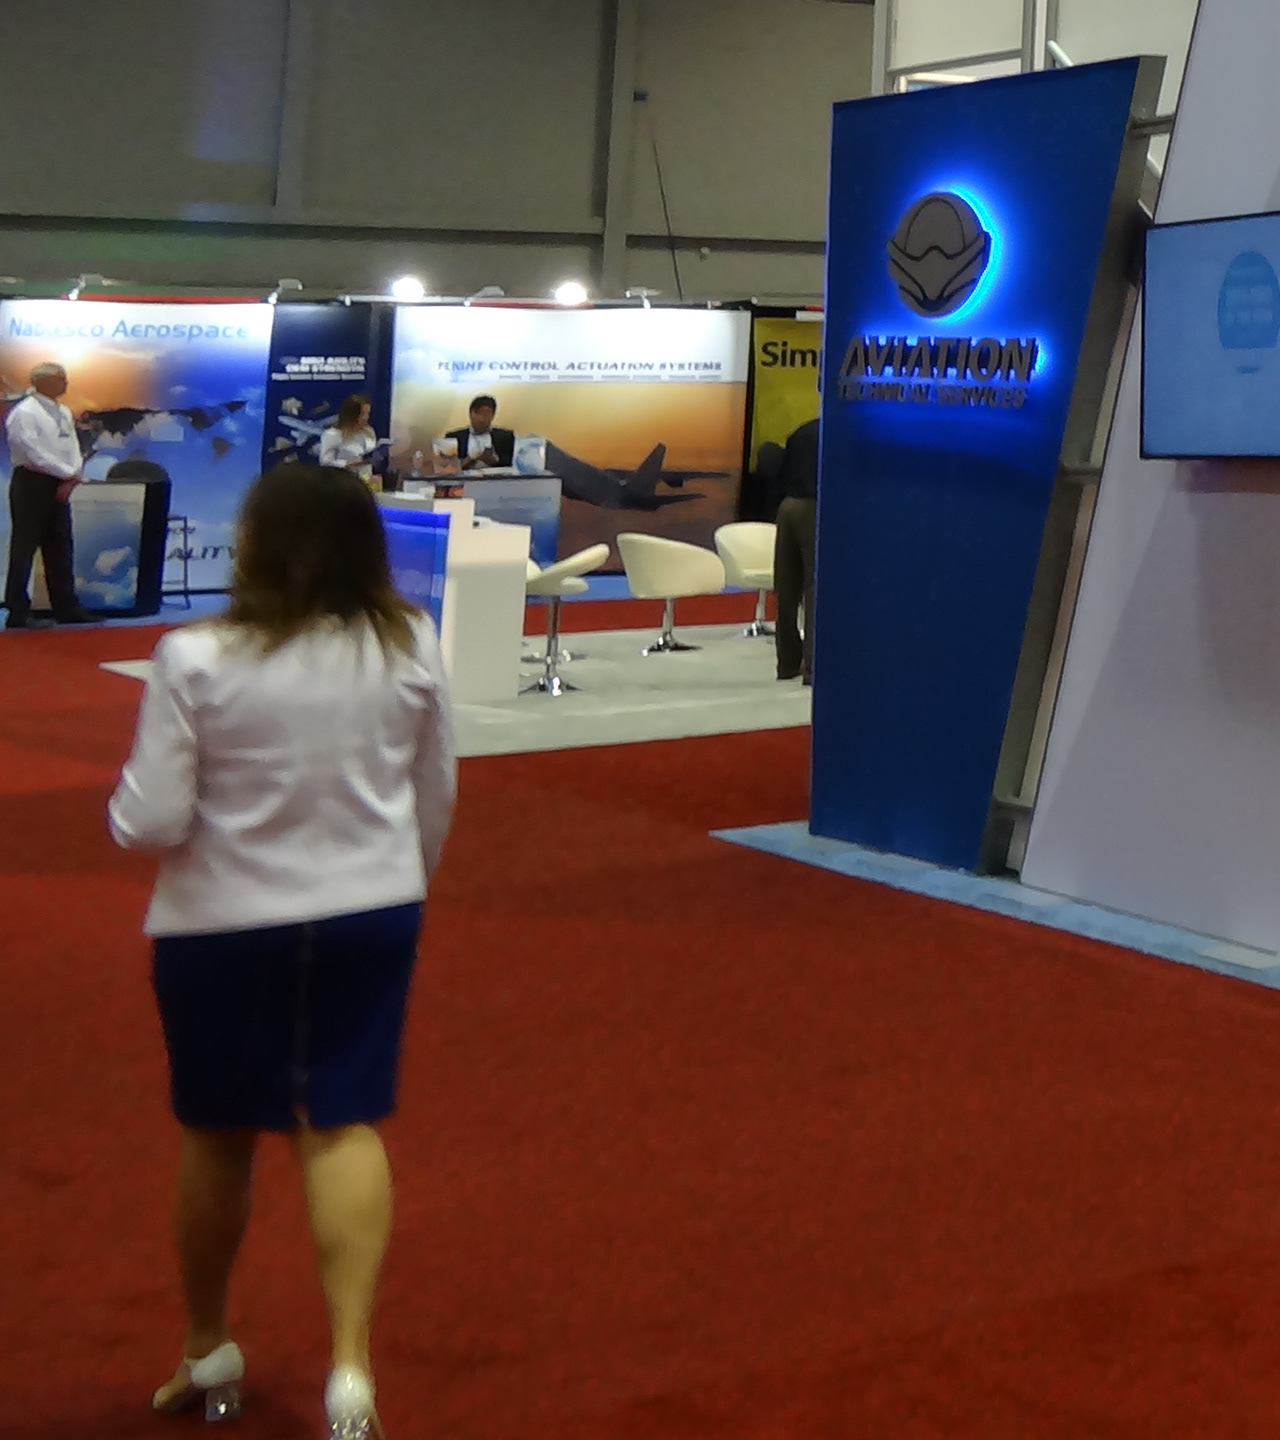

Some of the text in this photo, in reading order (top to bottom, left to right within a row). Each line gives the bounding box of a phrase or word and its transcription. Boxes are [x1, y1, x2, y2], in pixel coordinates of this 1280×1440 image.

[112, 320, 248, 341] Aerospace
[488, 361, 558, 371] CONTROL
[565, 362, 654, 371] ACTUATION
[659, 362, 722, 371] SYSTEMS
[839, 336, 1038, 382] AVIATION
